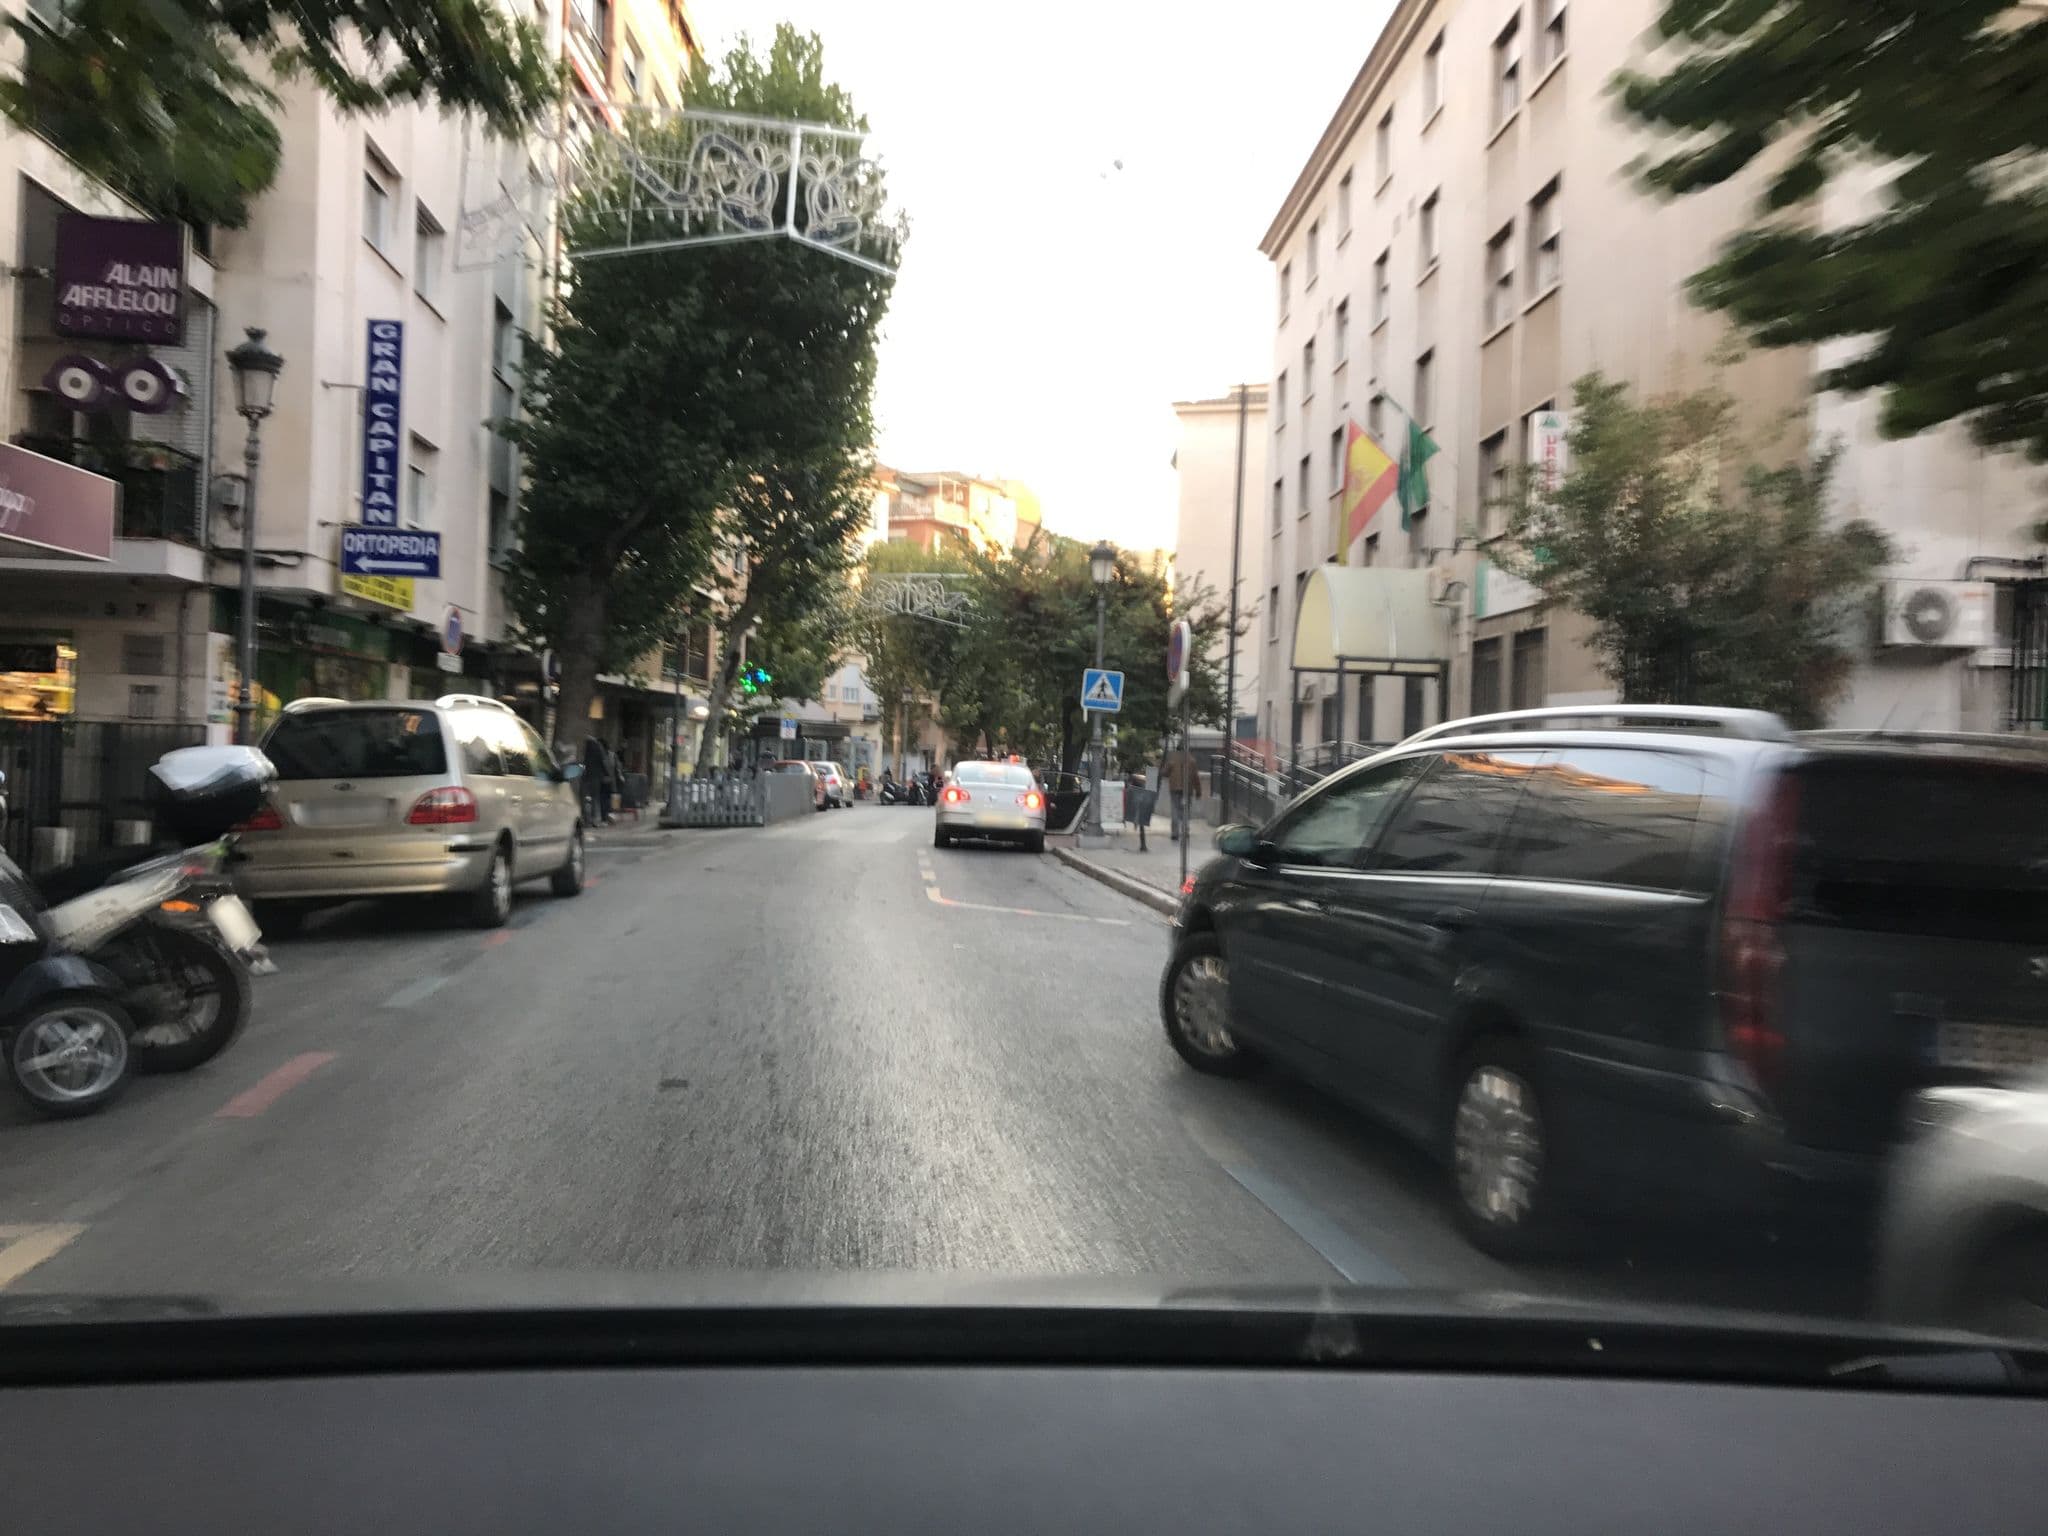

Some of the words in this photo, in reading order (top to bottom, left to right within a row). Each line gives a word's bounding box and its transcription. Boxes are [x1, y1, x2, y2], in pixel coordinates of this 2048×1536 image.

[104, 263, 178, 289] ALAIN
[62, 284, 176, 315] AFFLELOU
[371, 323, 398, 392] GRAN
[366, 402, 397, 523] CAPITAN
[343, 532, 438, 556] ORTOPEDIA
